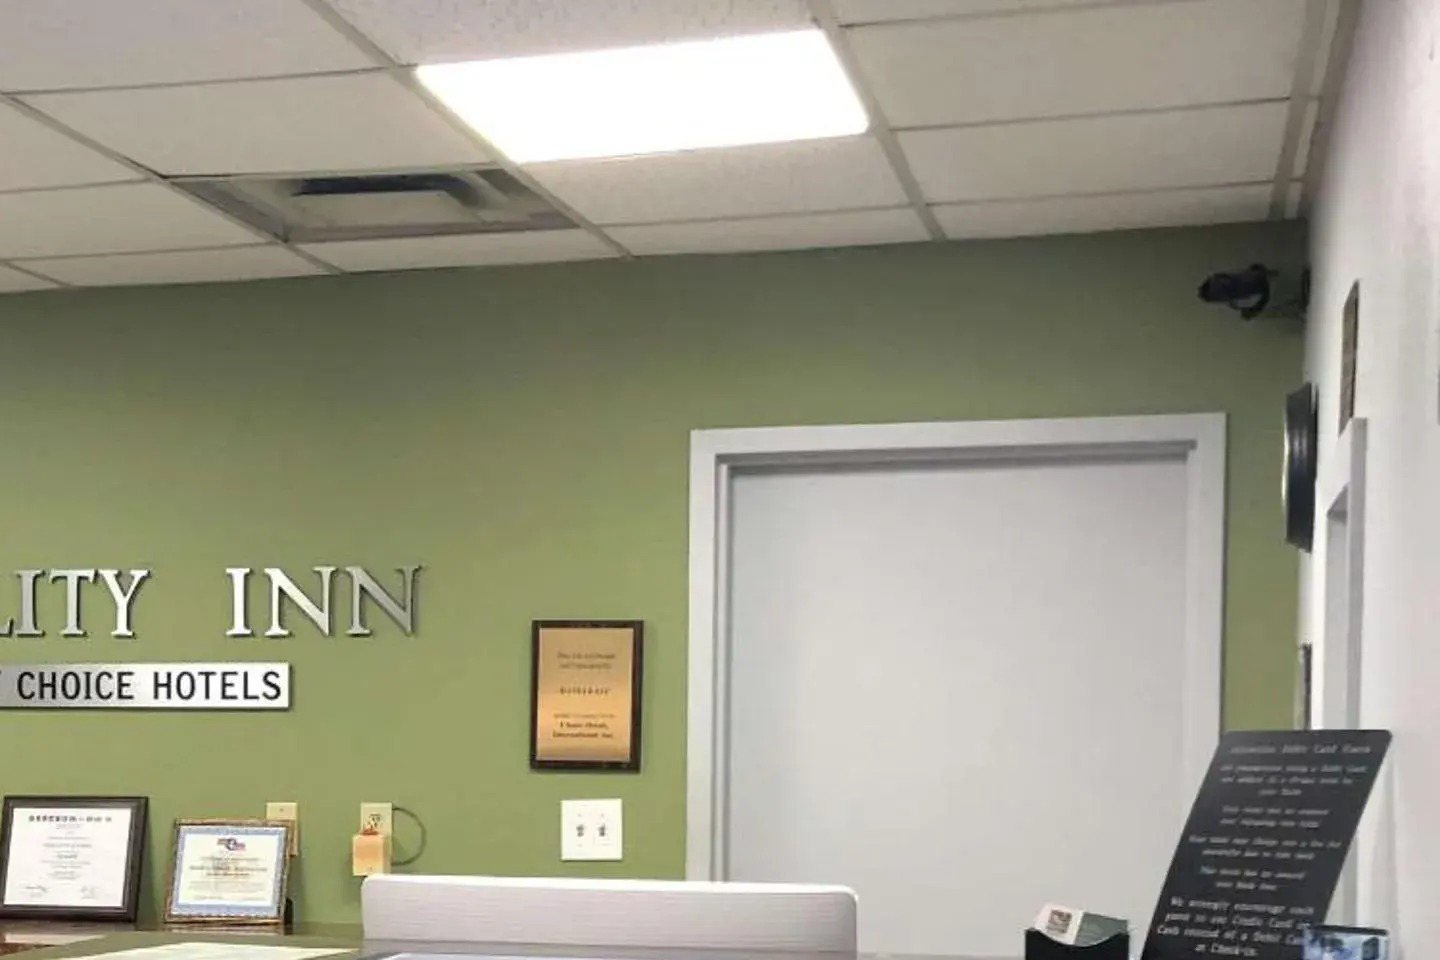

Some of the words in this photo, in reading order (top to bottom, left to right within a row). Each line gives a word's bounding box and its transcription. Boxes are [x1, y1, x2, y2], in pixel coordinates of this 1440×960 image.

[225, 564, 422, 638] INN
[17, 671, 135, 701] CHOICE
[152, 671, 283, 701] HOTELS
